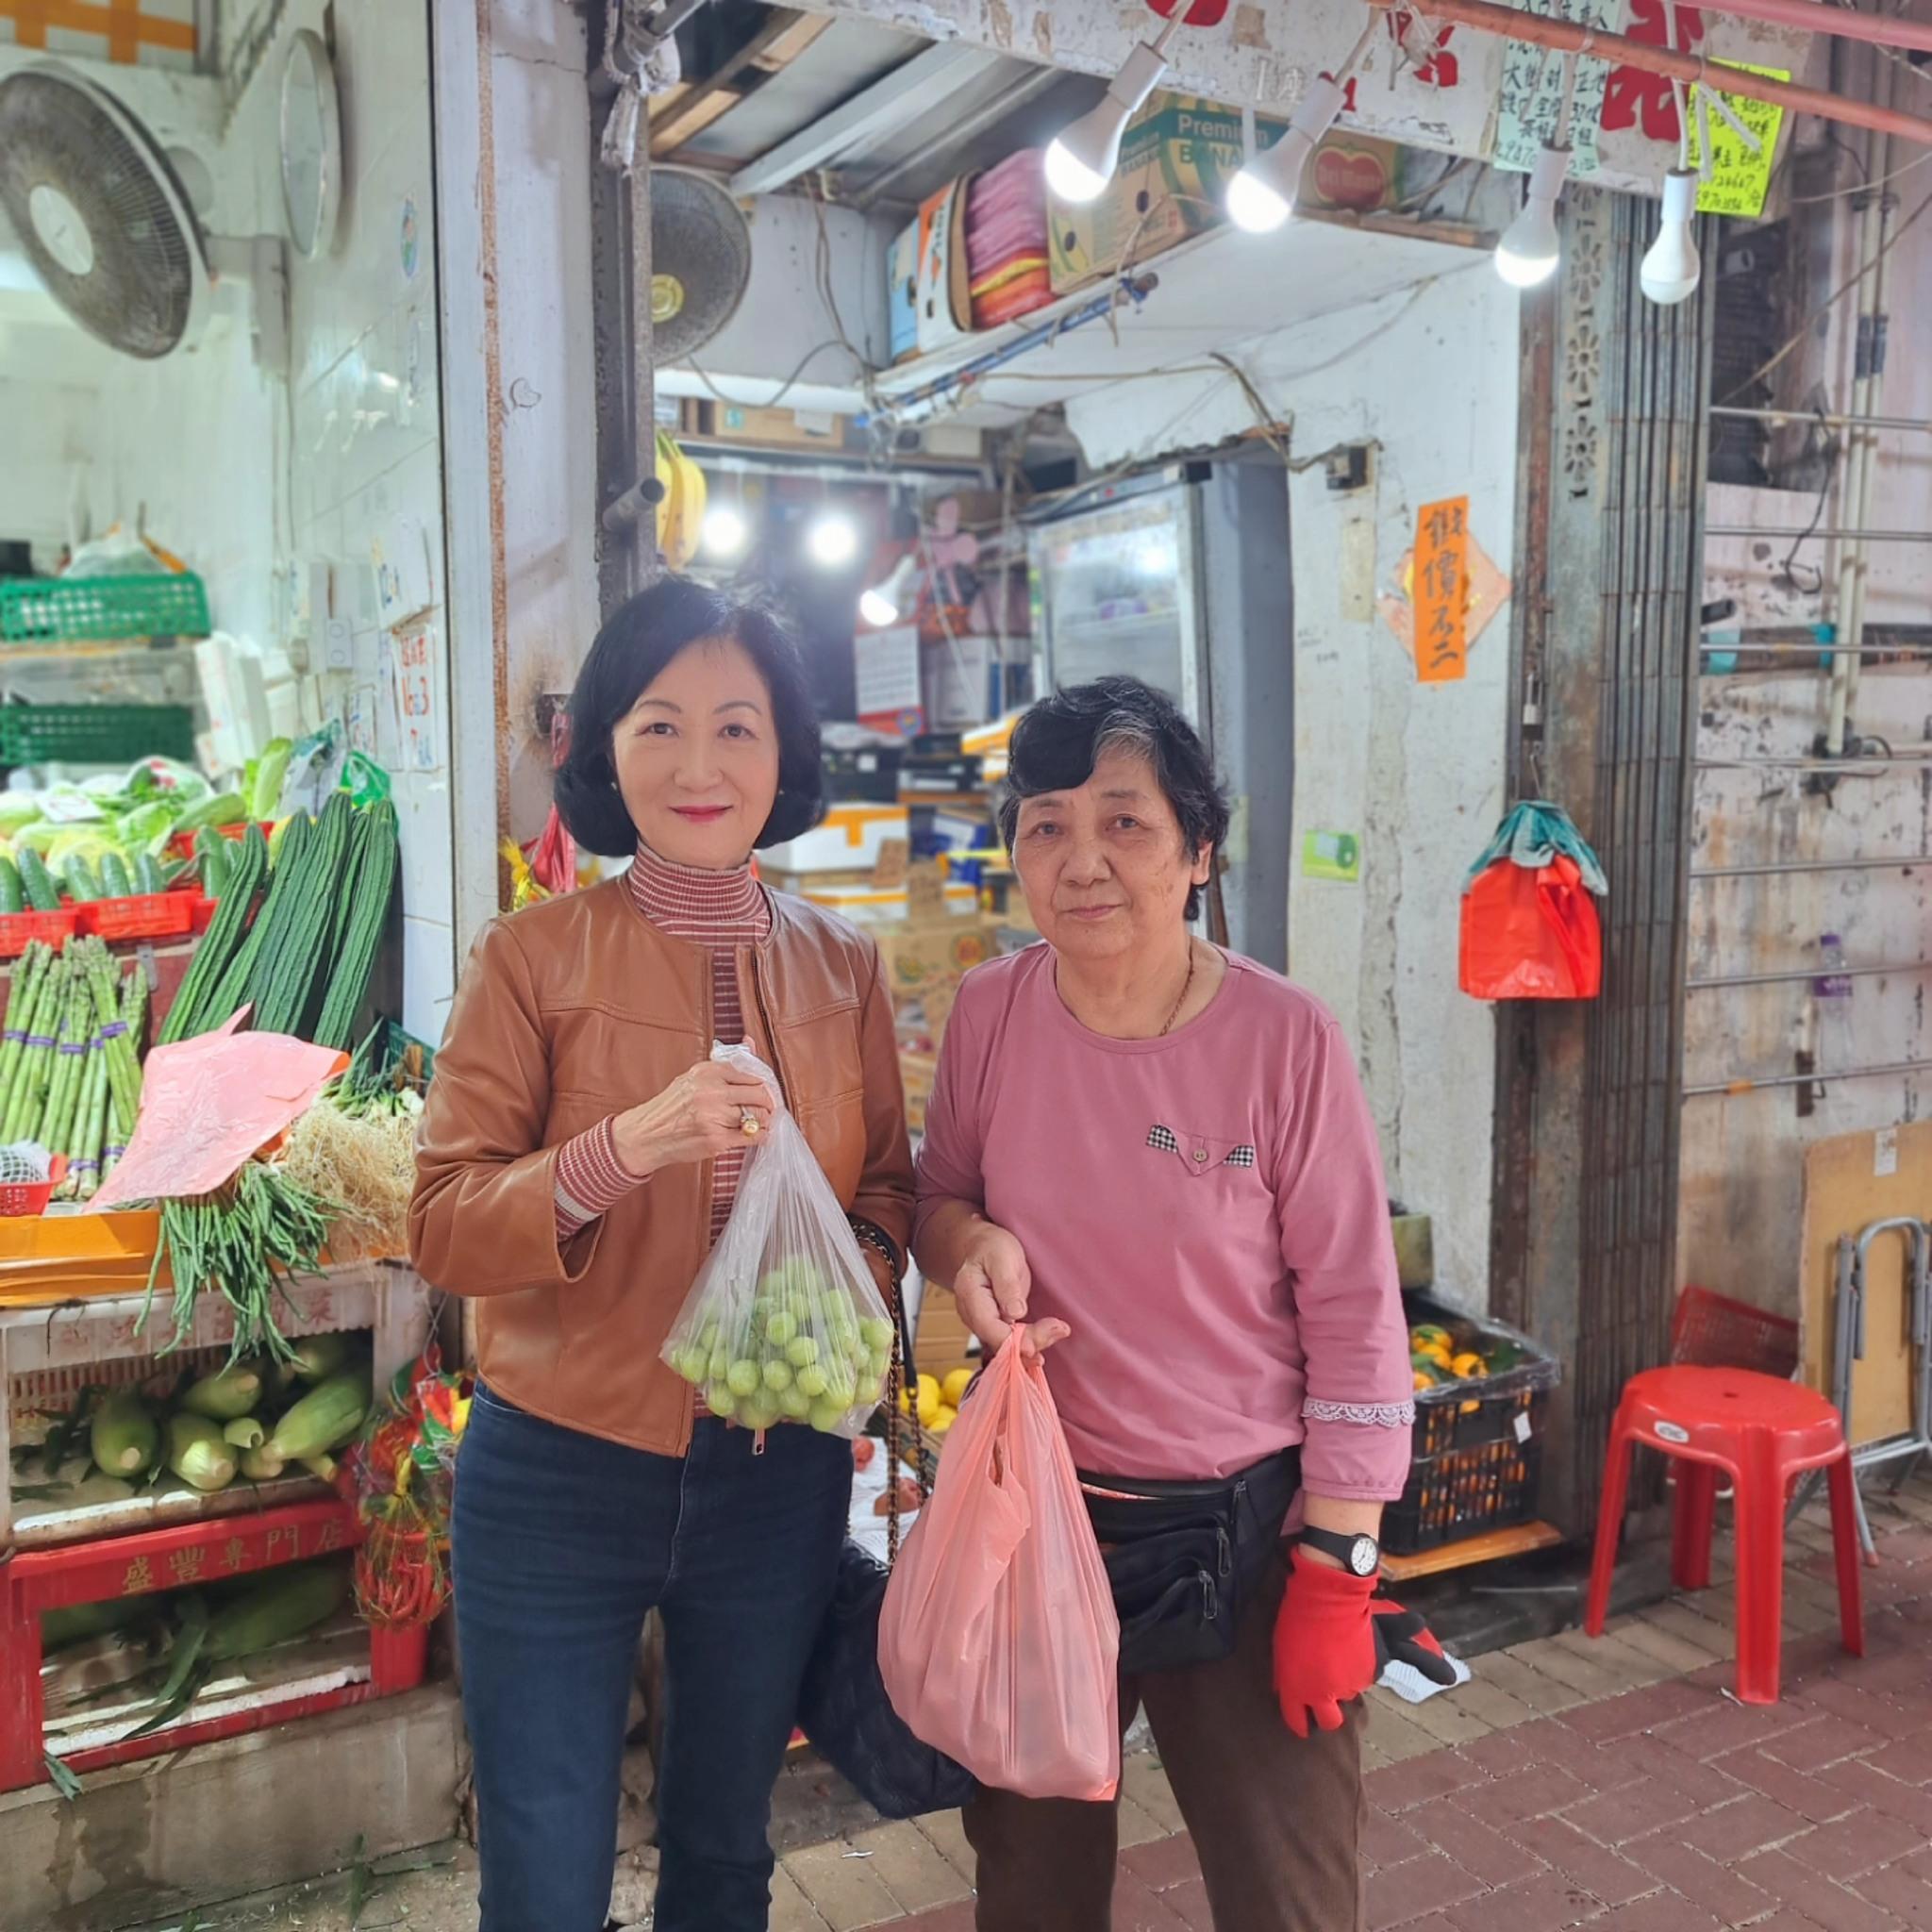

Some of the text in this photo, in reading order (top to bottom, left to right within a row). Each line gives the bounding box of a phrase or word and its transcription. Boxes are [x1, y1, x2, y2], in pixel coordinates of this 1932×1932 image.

[1177, 113, 1269, 148] Premim
[122, 1518, 345, 1594] 盛豐專門店
